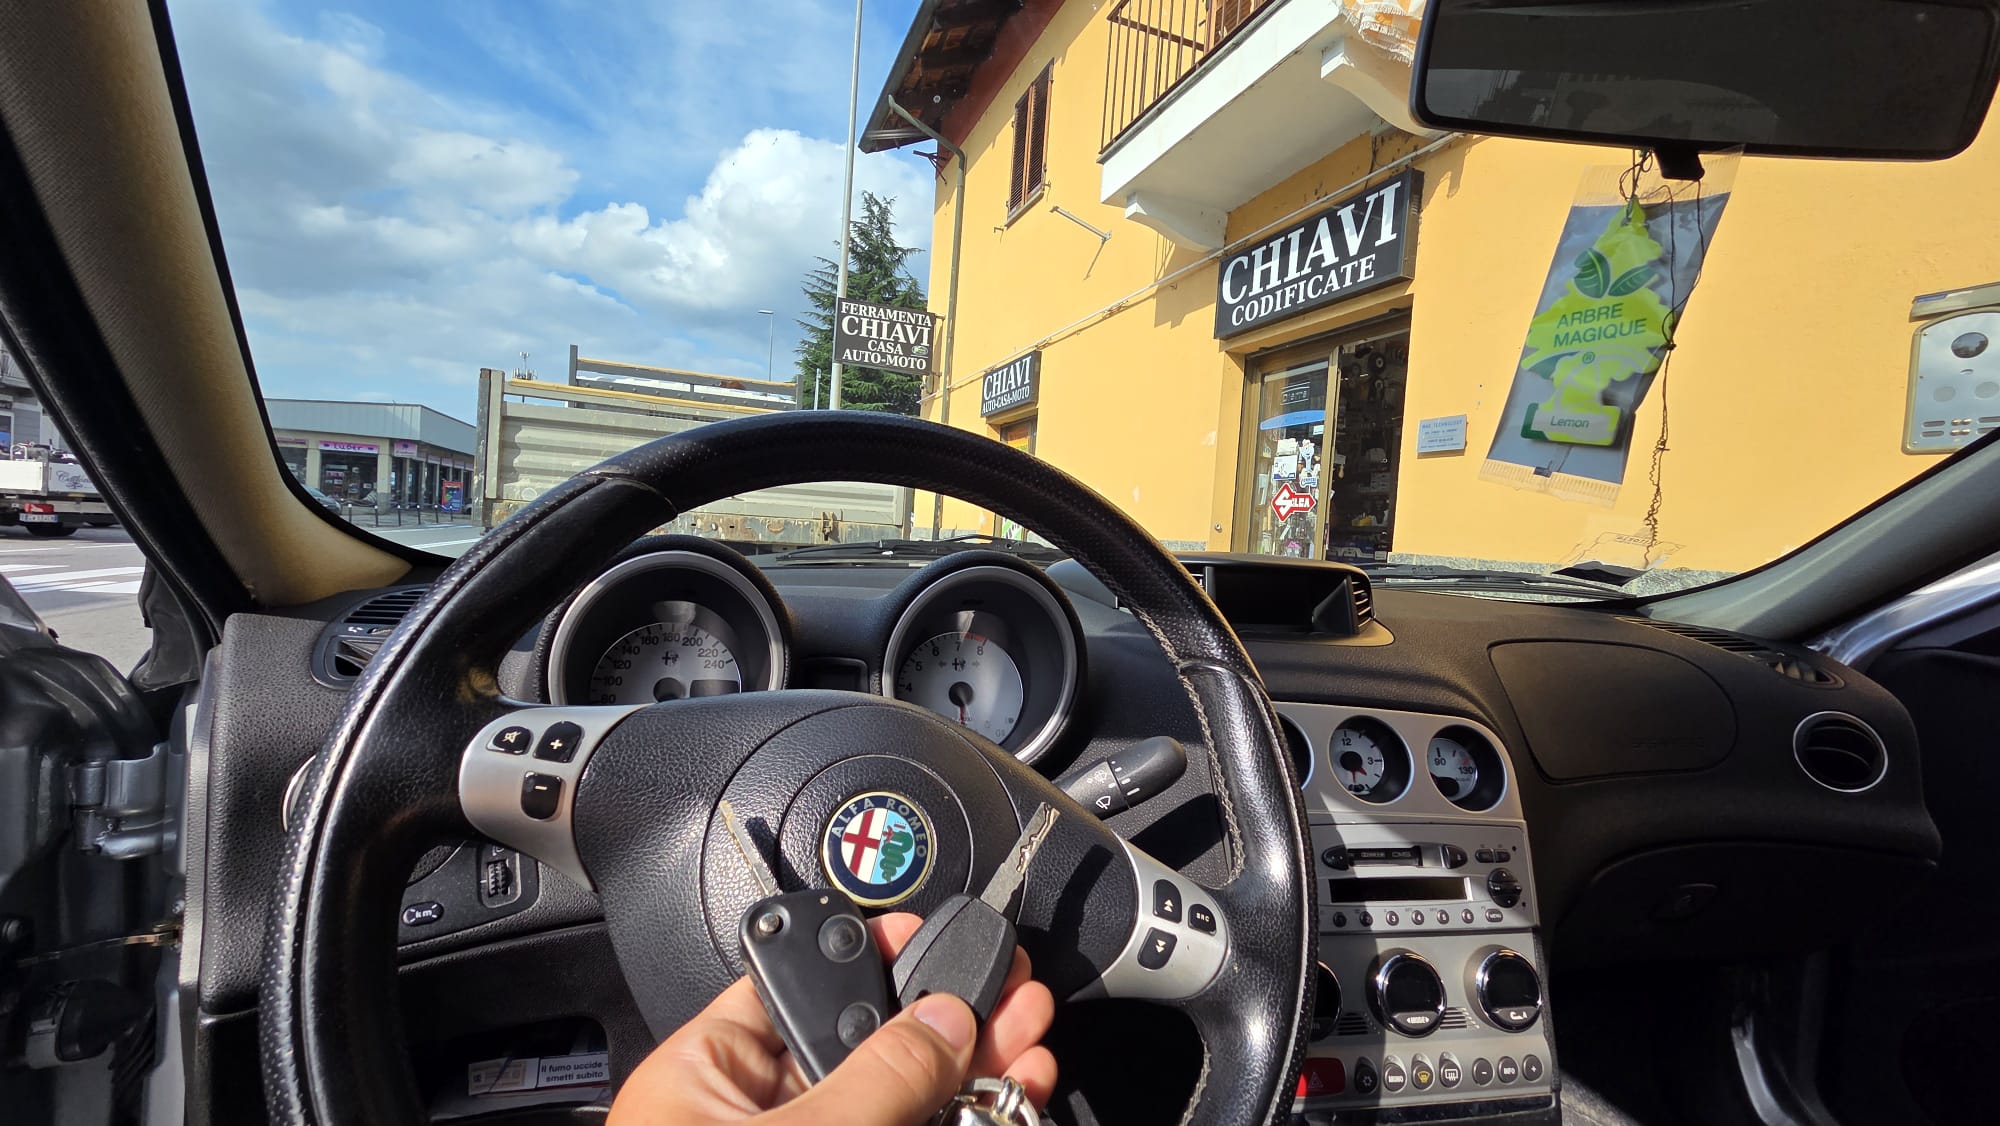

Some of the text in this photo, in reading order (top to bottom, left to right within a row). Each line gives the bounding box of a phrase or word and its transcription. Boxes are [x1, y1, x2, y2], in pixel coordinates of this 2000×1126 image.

[1222, 182, 1401, 305] CHIAVI
[1231, 254, 1376, 326] CODIFICATE
[841, 302, 932, 327] FERRAMENTA
[1557, 302, 1624, 328] ARBRE
[841, 315, 931, 347] CHIAVI
[1553, 318, 1647, 348] MAGIQUE
[867, 340, 903, 355] CASA
[842, 348, 926, 370] AUTO-MOTO
[984, 355, 1032, 400] CHIAVI
[982, 385, 1030, 414] AUTO-CASA-MOTO
[1550, 416, 1589, 428] Lemon
[641, 635, 659, 646] 160
[662, 631, 681, 643] 180
[682, 636, 703, 647] 200
[622, 645, 641, 656] 140
[932, 646, 939, 656] 6
[954, 641, 961, 651] 7
[976, 646, 984, 656] 8
[697, 647, 719, 658] 220
[614, 659, 632, 670] 120
[703, 659, 725, 670] 240
[914, 661, 923, 672] 5
[905, 683, 912, 692] 4
[1341, 738, 1352, 746] 12
[1367, 757, 1374, 765] 3
[1434, 758, 1446, 766] 90
[1458, 766, 1474, 775] 130
[832, 798, 927, 857] ALFA ROMEO
[415, 909, 432, 918] km
[549, 1064, 571, 1073] fumo
[573, 1061, 602, 1071] uccide
[546, 1071, 603, 1082] smetti subito
